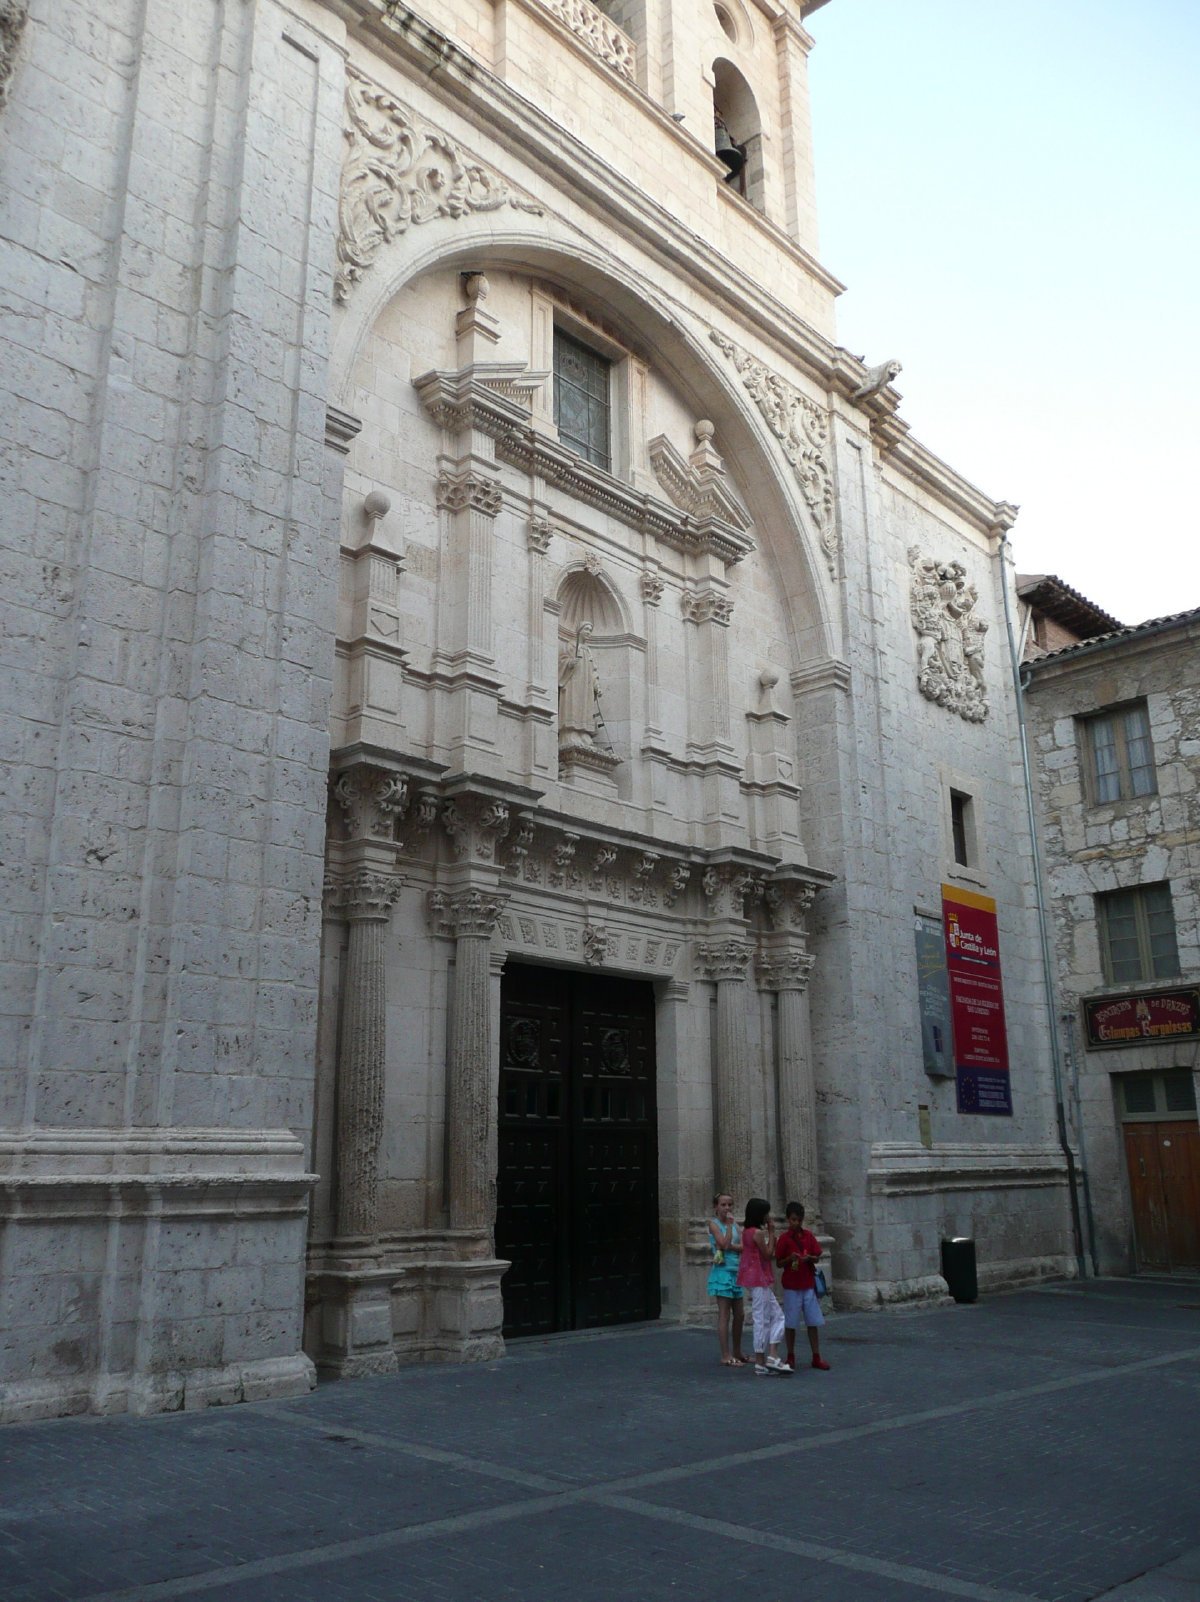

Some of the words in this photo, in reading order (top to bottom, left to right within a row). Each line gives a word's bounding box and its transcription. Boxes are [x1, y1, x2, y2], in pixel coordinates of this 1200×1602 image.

[960, 930, 974, 941] Junta
[975, 934, 982, 943] de
[961, 941, 979, 952] Castilla
[984, 946, 996, 956] León
